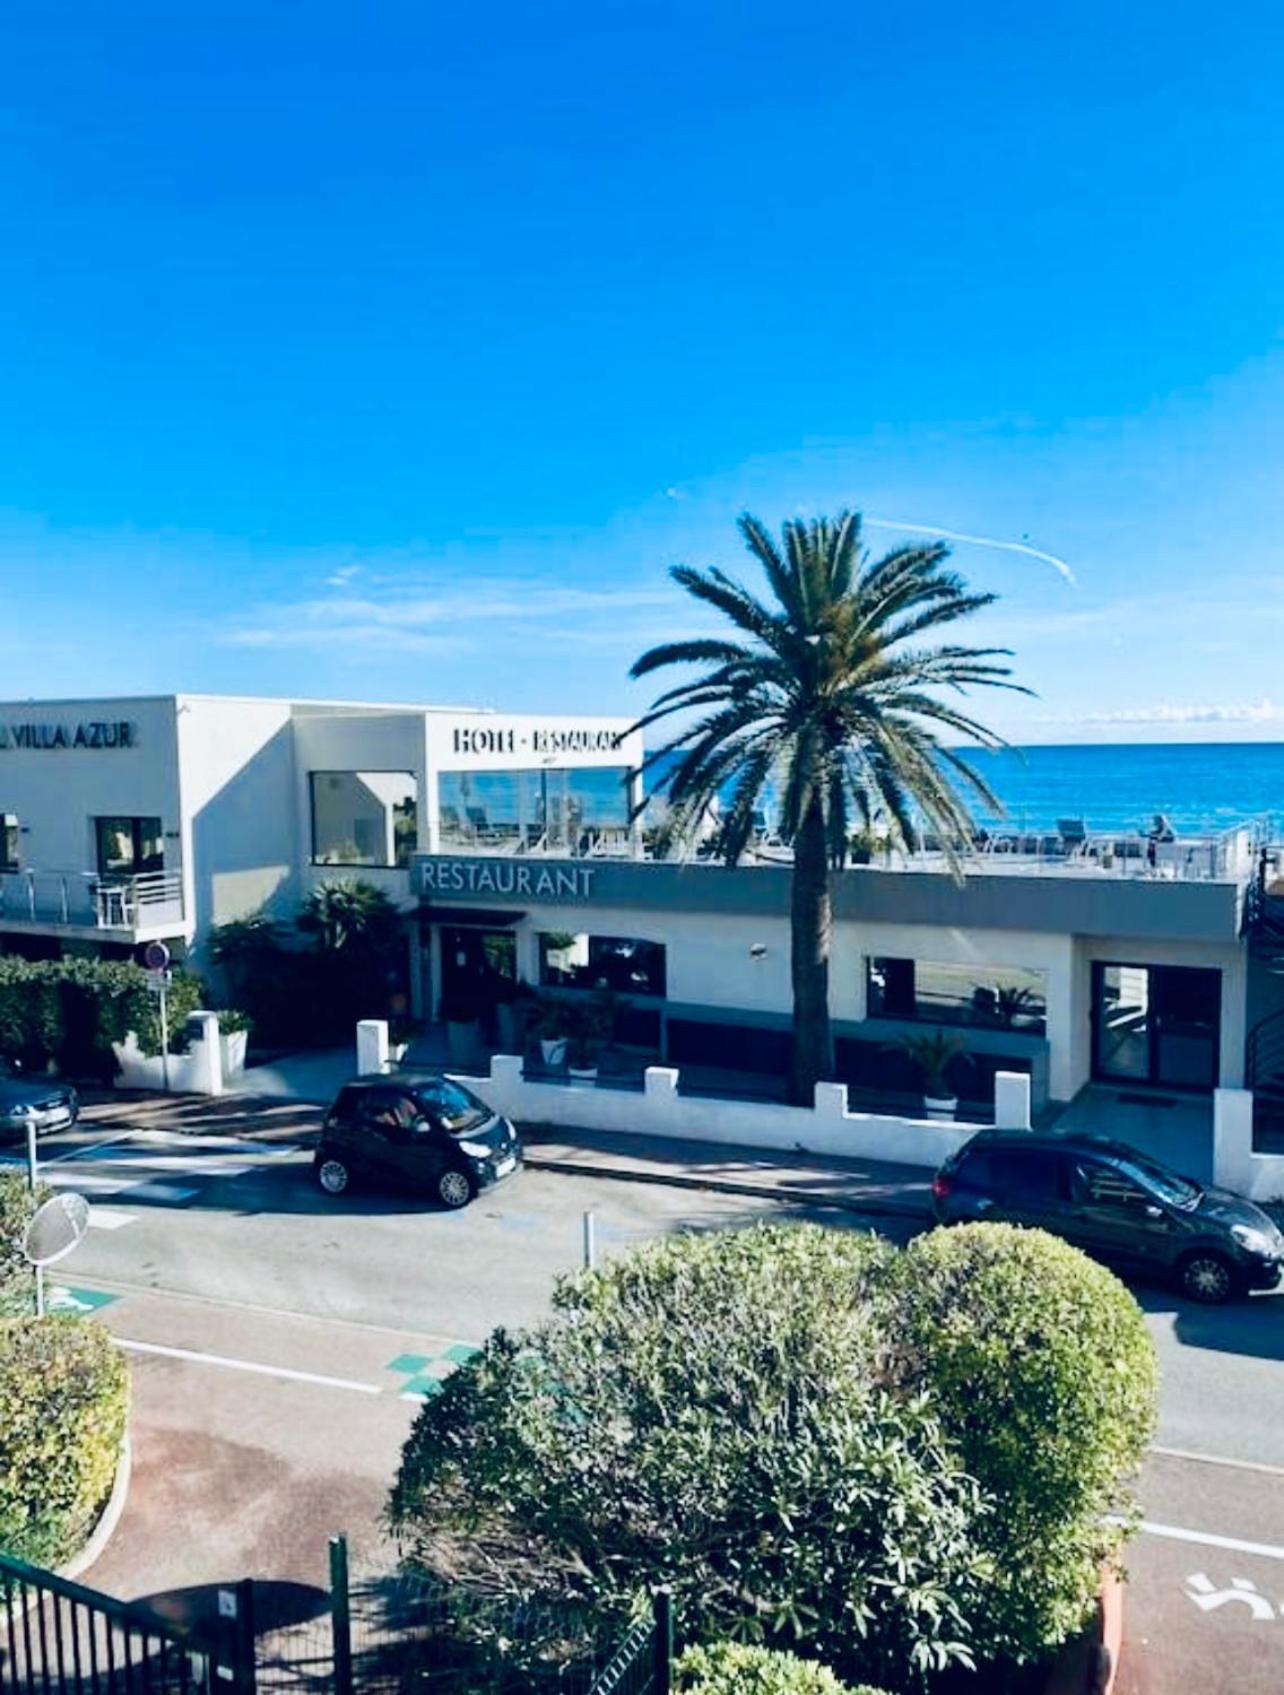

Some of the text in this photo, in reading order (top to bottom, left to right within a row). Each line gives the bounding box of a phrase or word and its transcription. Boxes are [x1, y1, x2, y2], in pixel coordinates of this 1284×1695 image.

[11, 723, 67, 749] VILLA
[73, 720, 135, 749] AZUR
[421, 862, 595, 897] RESTAURANT
